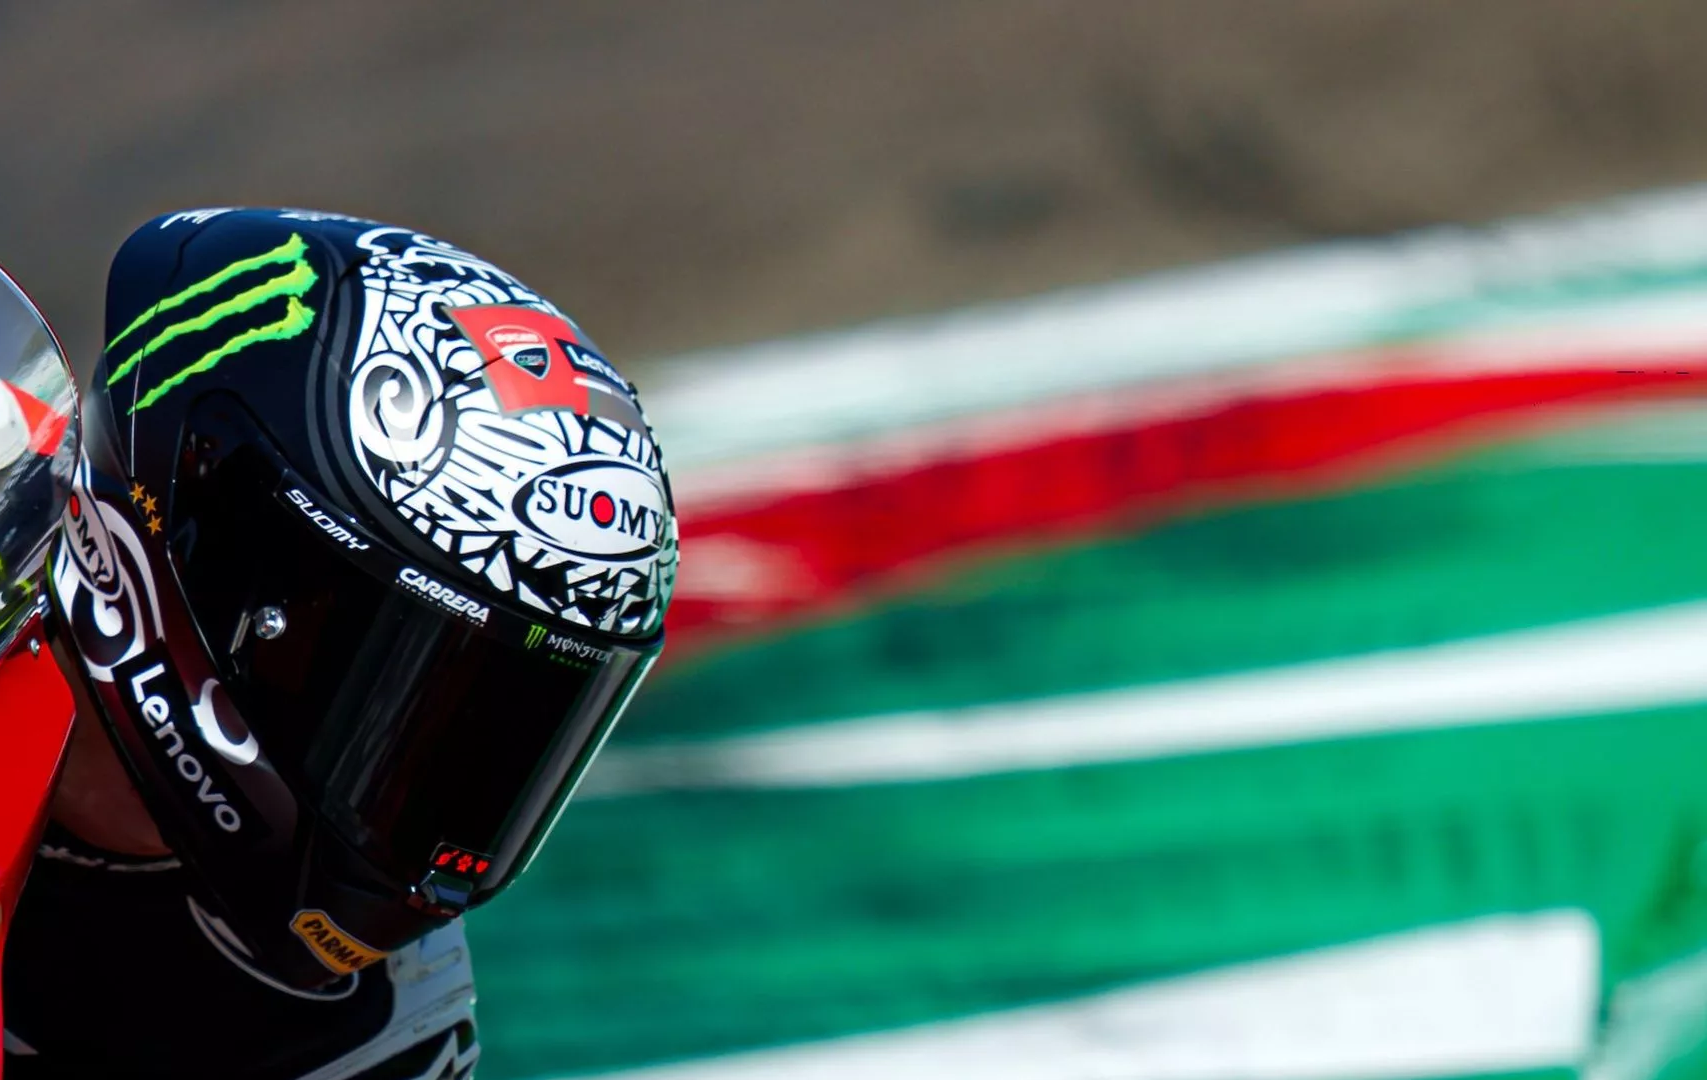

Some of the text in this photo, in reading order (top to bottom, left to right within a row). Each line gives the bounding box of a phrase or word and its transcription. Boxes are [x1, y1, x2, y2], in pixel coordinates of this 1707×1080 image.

[69, 490, 110, 584] OMY
[286, 488, 370, 550] SUOMY
[537, 478, 664, 546] SUOMY
[399, 567, 490, 623] CARRERA
[131, 663, 242, 833] Lenovo
